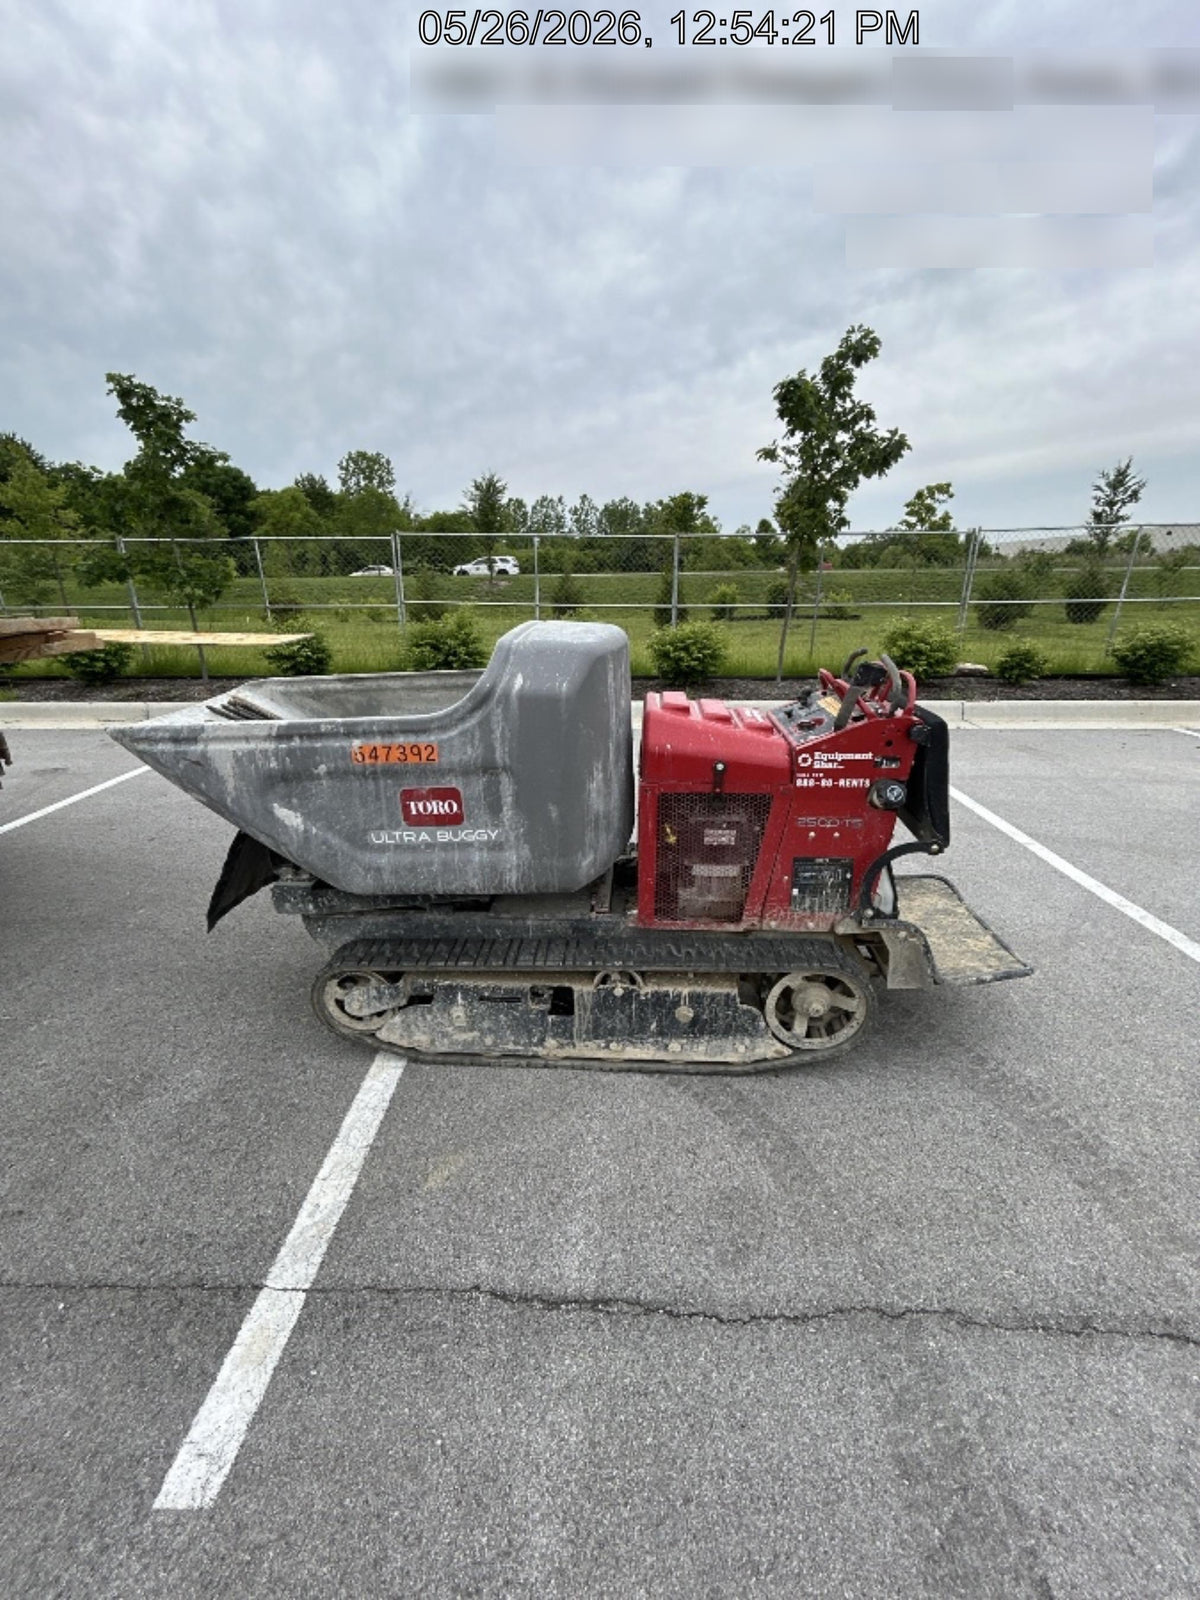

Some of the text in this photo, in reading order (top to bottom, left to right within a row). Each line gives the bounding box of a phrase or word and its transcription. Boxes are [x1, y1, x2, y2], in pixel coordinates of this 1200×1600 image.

[813, 752, 874, 761] Equipment
[406, 800, 459, 815] TORO
[371, 829, 499, 844] ULTRA BUGGY
